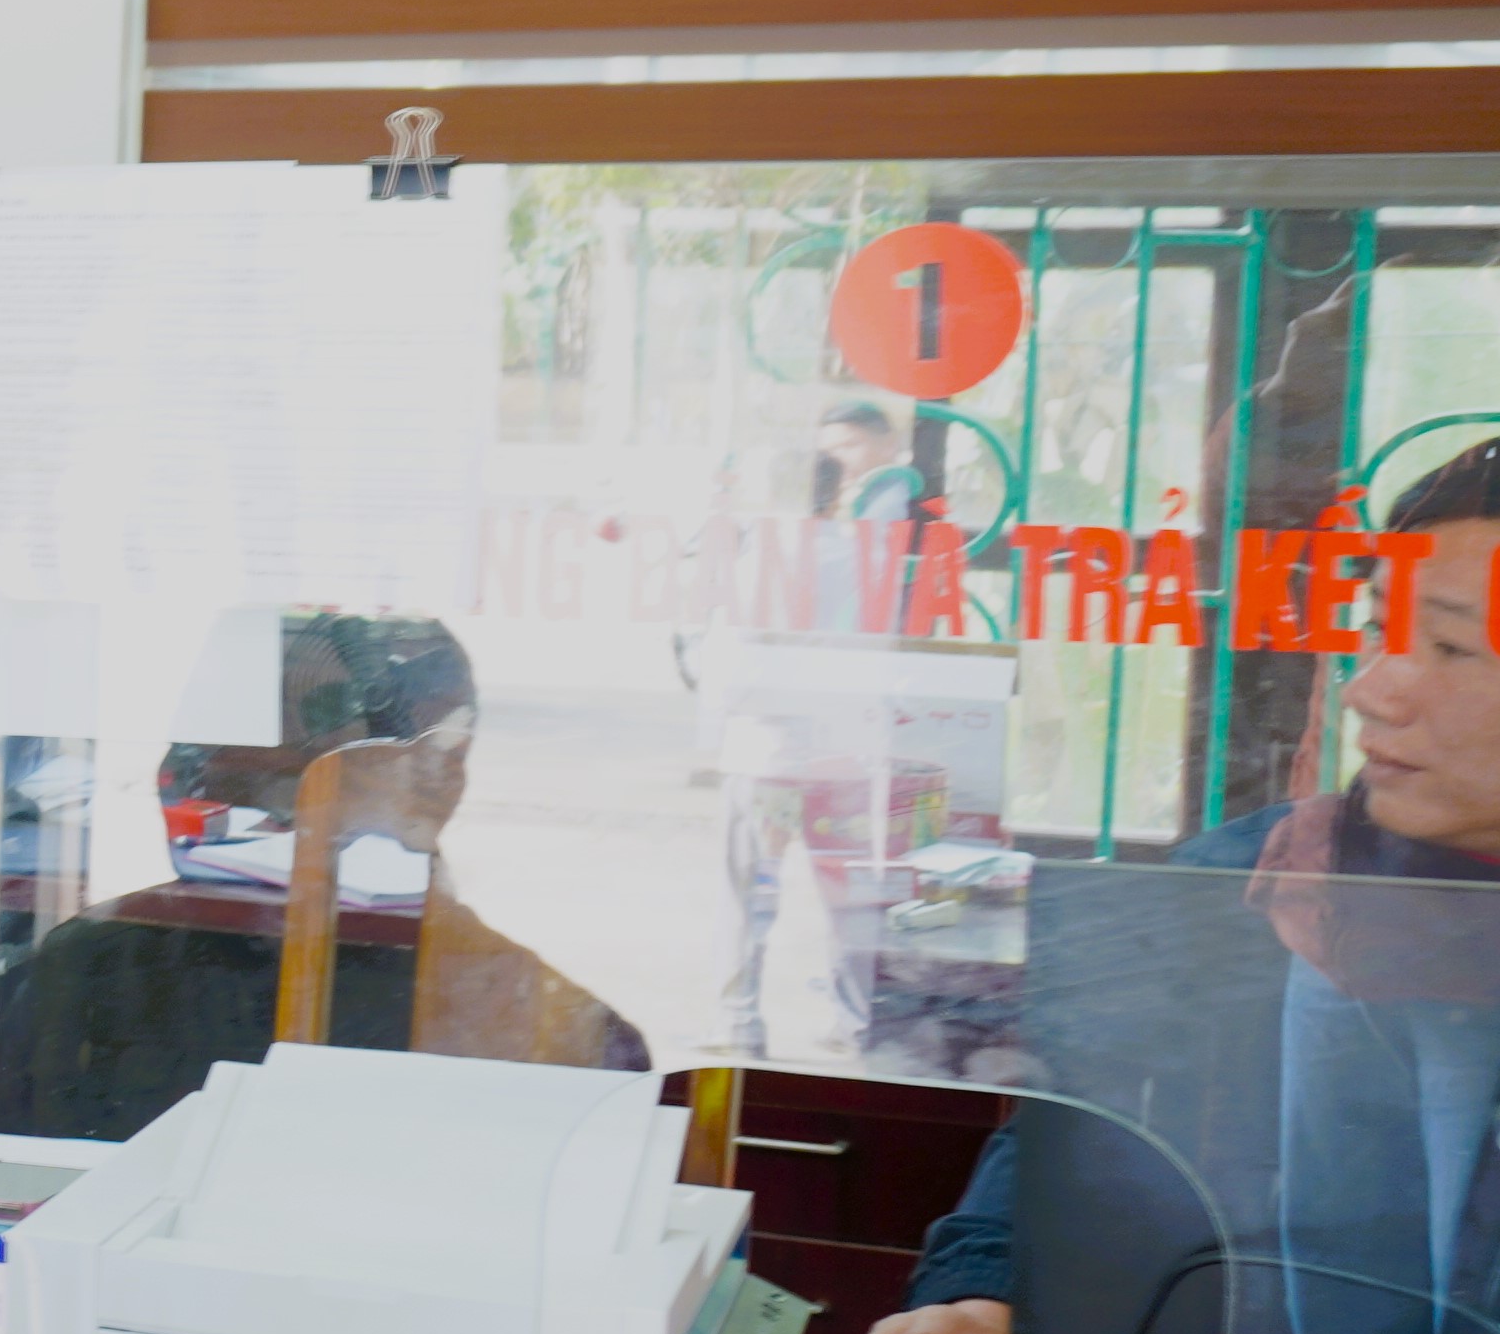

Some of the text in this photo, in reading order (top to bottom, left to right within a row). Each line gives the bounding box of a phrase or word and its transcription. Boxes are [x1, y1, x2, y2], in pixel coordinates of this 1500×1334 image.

[893, 262, 943, 361] 1
[856, 496, 966, 637] VÀ
[1012, 486, 1203, 648] TRẢ
[1231, 484, 1435, 656] KẾT
